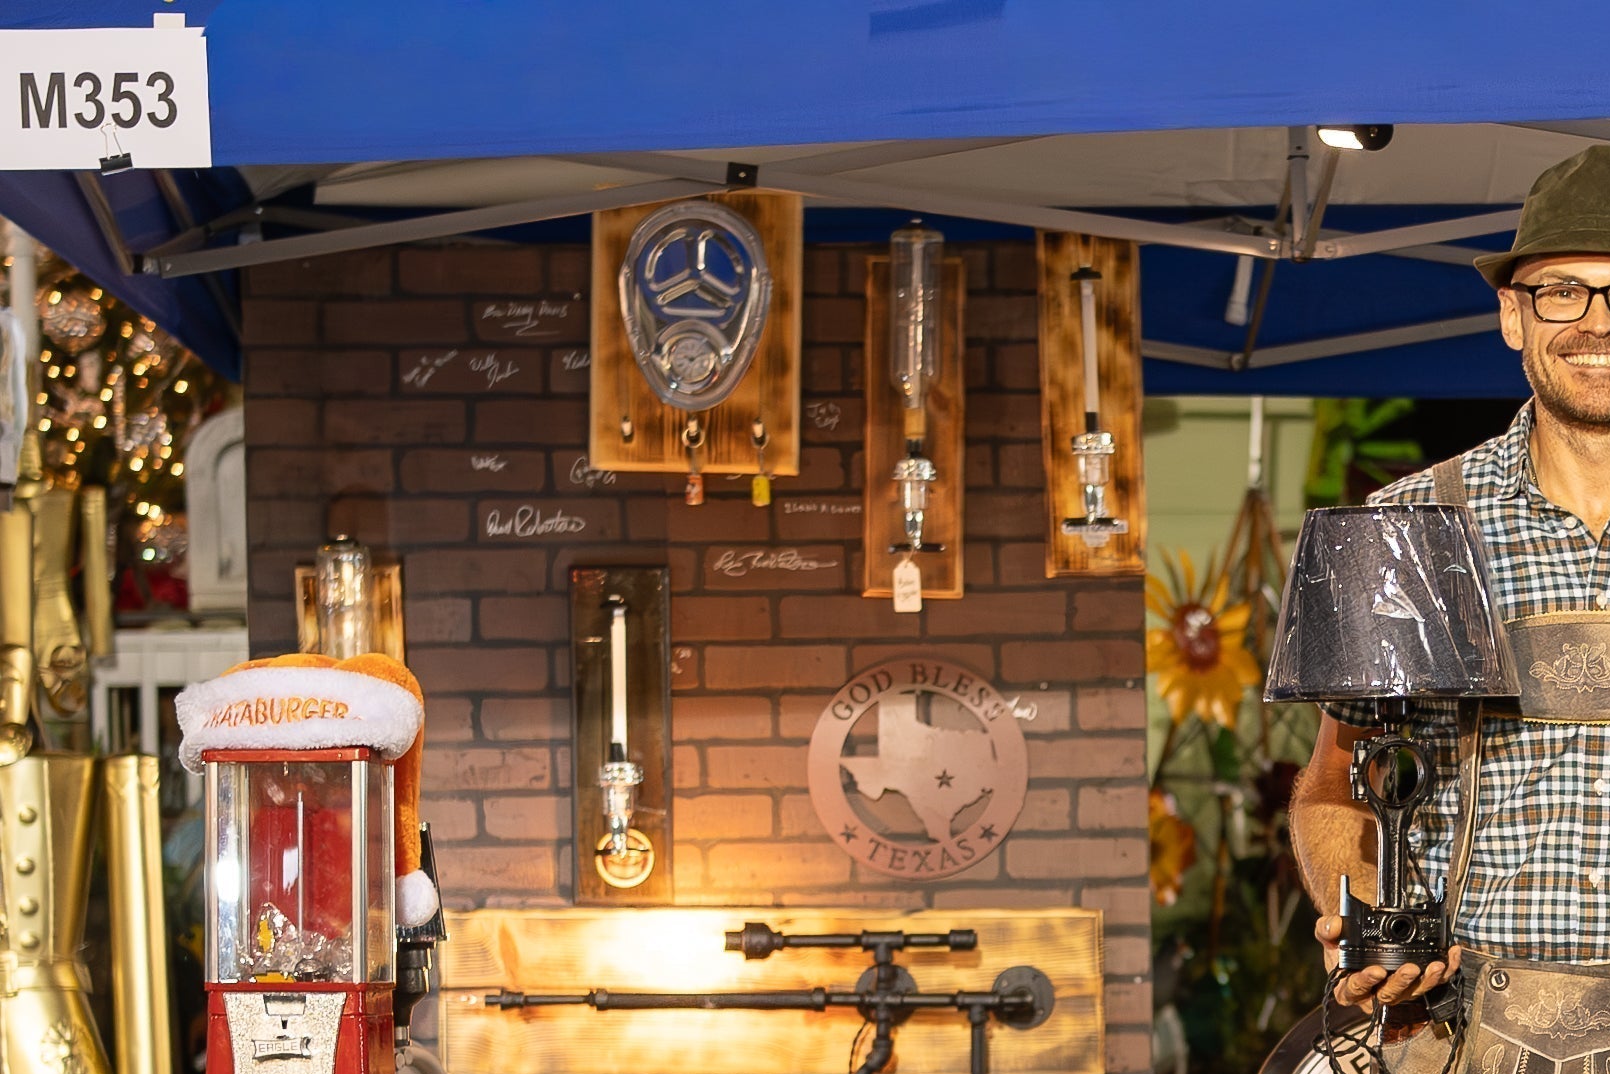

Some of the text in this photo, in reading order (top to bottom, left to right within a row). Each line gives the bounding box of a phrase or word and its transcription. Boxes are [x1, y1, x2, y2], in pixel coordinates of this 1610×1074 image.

[20, 71, 178, 129] M353
[832, 669, 893, 721] GOD
[909, 663, 1004, 721] BLESS
[867, 838, 976, 873] TEXAS
[258, 1041, 298, 1053] EAGLE
